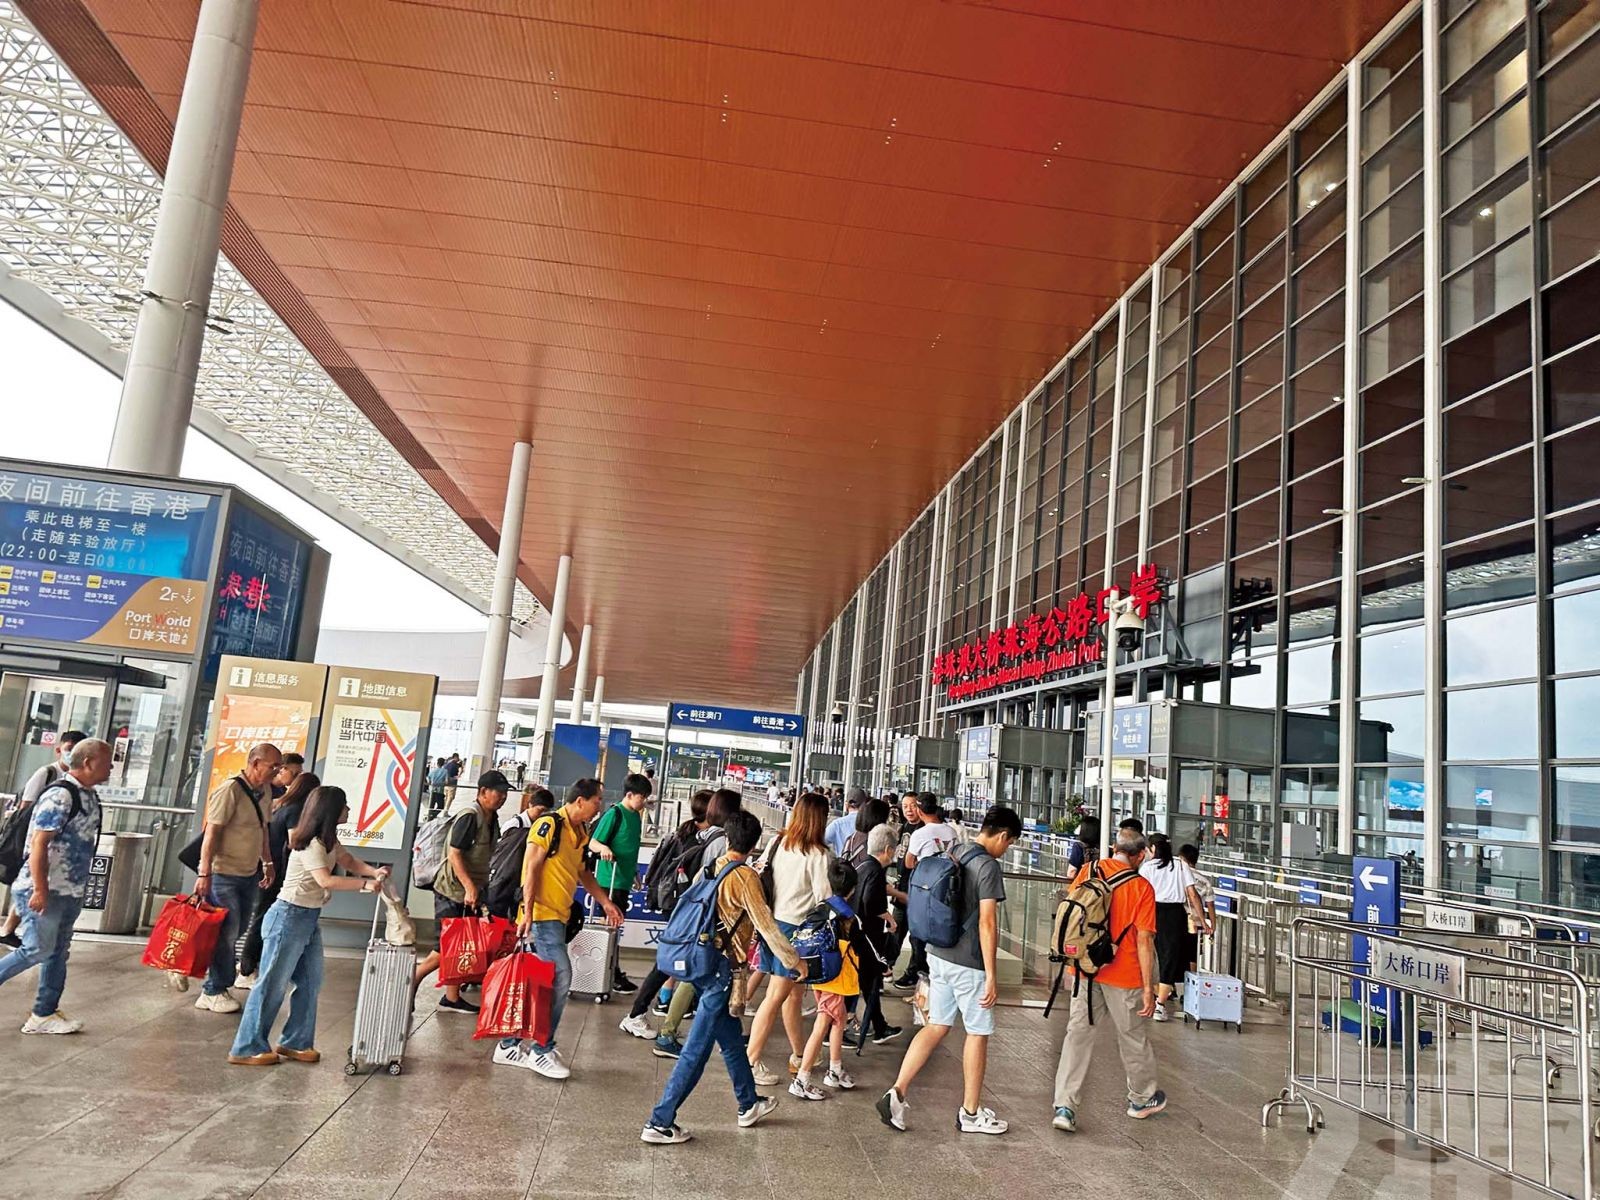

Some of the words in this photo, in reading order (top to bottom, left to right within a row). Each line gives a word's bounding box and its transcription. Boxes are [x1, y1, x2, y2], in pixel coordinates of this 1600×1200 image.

[0, 475, 191, 521] 夜间前往香港
[24, 509, 148, 537] 乘此电梯至一楼
[160, 586, 179, 602] 2F
[125, 611, 152, 623] Port
[155, 613, 191, 627] World
[129, 628, 181, 645] 口岸天地
[1077, 637, 1102, 664] Port
[254, 672, 299, 686] 信息服务
[362, 683, 408, 697] 地图信息
[690, 709, 722, 721] 前往澳门
[752, 716, 785, 727] 前往香港
[341, 717, 387, 731] 谁在表达
[339, 729, 387, 744] 当代中国
[1431, 911, 1467, 929] 大桥口岸
[1385, 952, 1449, 984] 大桥口岸
